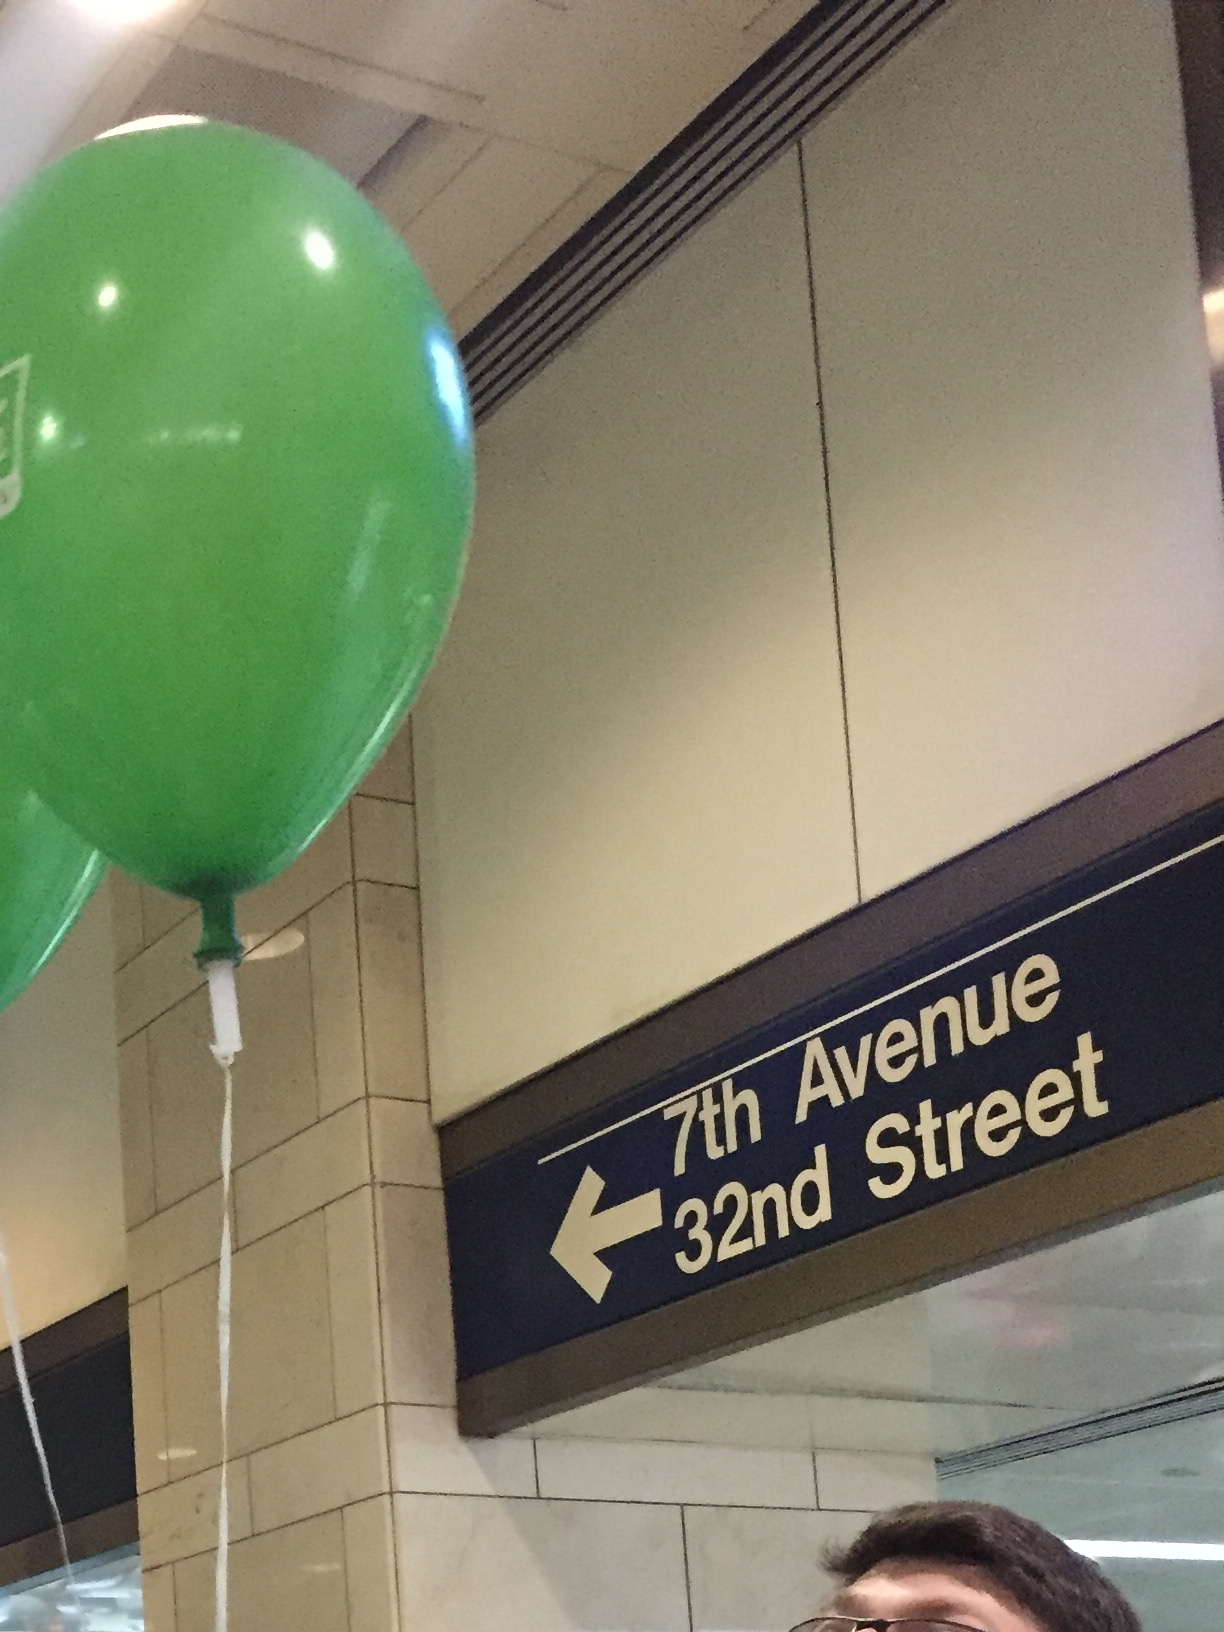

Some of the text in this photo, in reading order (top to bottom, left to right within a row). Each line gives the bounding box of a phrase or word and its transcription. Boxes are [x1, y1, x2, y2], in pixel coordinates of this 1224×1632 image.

[663, 953, 1061, 1177] 7th Avenue
[674, 1031, 1110, 1275] 32nd Street
